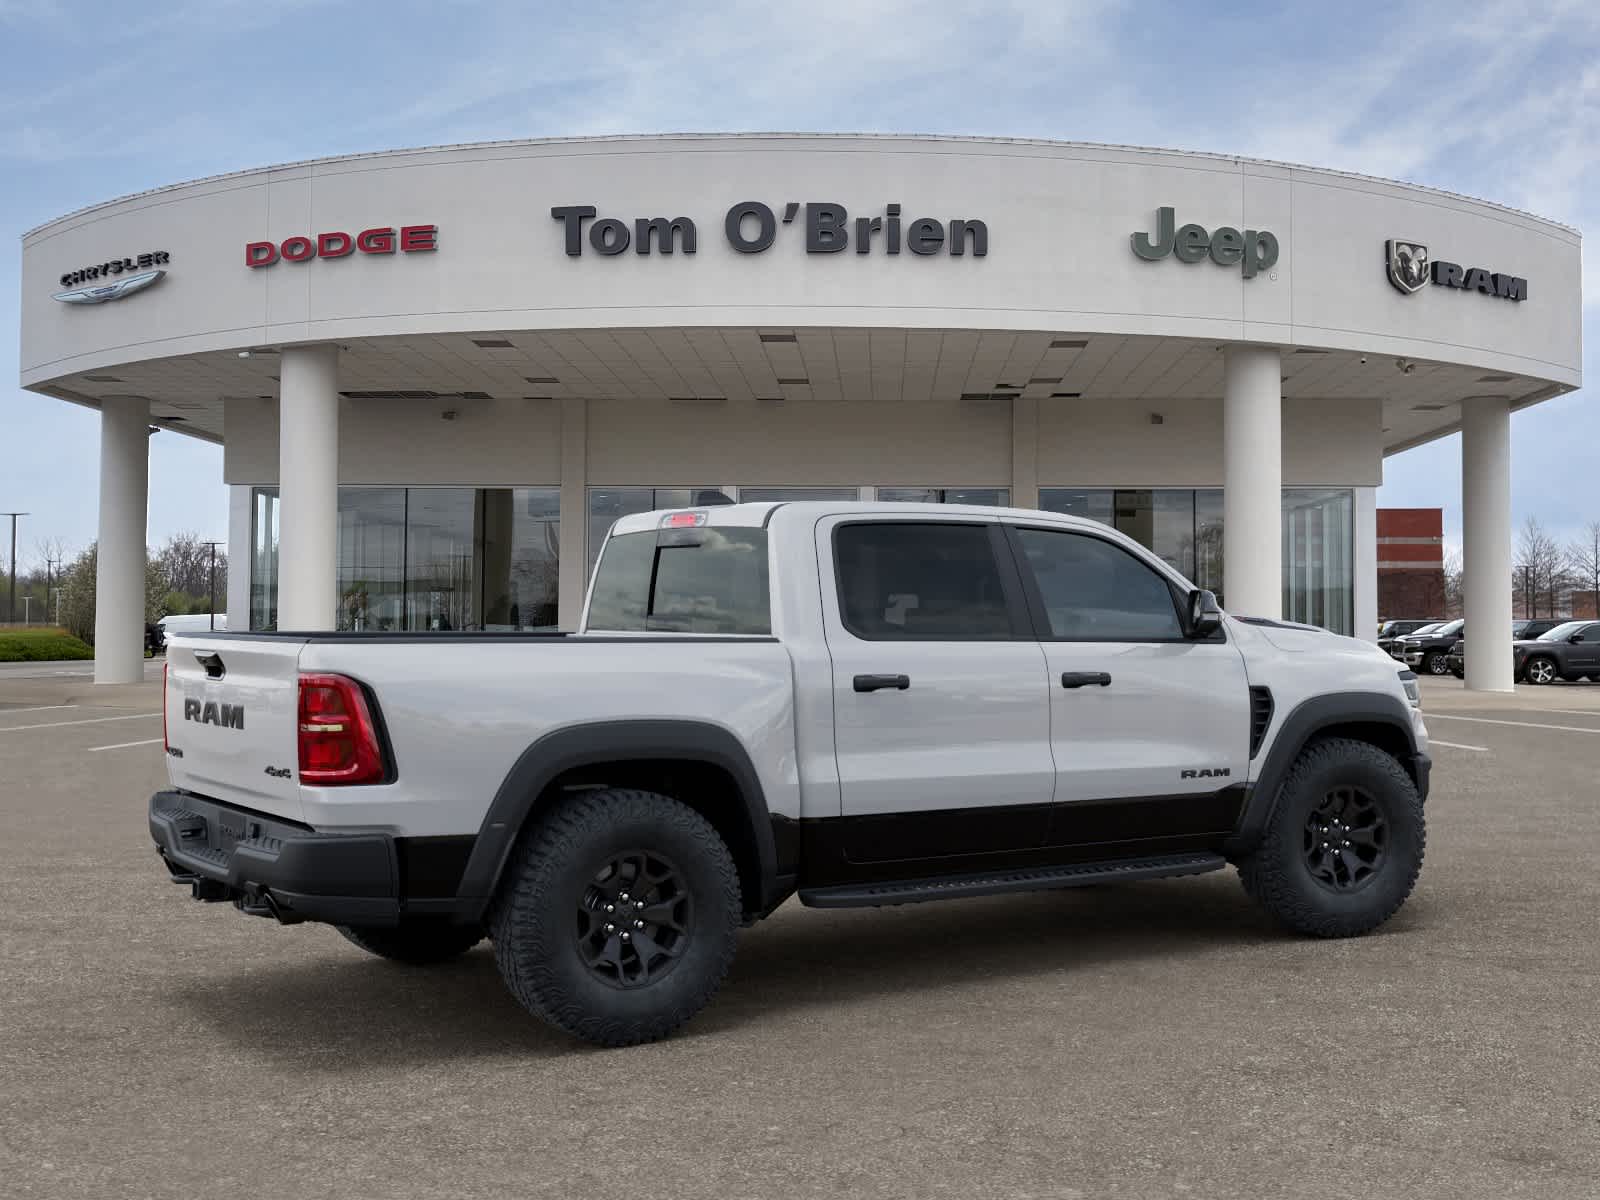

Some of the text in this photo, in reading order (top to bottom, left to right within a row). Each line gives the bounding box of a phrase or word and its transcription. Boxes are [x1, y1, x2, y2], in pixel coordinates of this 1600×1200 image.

[245, 224, 438, 269] DODGE
[551, 205, 697, 257] Tom
[1130, 206, 1279, 279] Jeep
[60, 249, 170, 288] CHRYSLER
[1431, 260, 1528, 301] RAM
[184, 698, 245, 730] RAM
[1181, 768, 1230, 779] RAM
